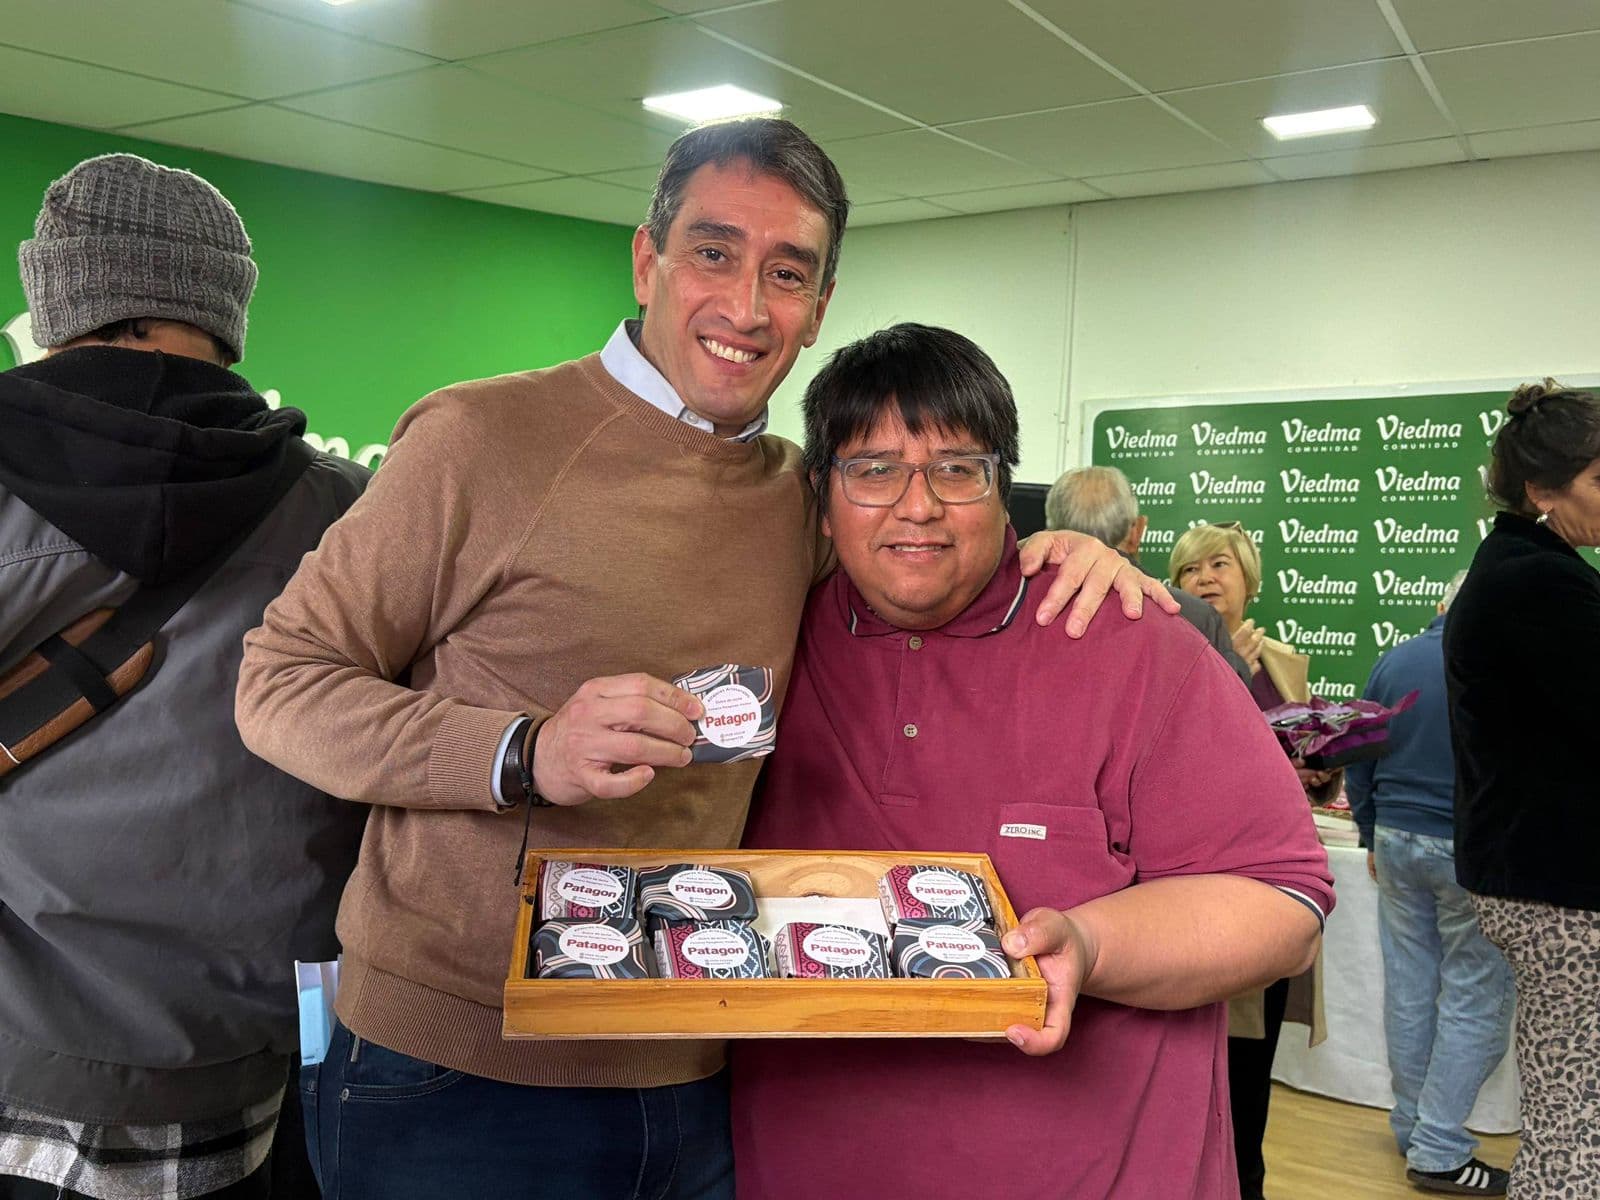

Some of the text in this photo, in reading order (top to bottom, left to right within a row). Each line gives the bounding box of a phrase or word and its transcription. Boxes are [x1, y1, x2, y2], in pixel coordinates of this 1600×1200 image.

[1281, 419, 1361, 443] Viedma
[1376, 415, 1462, 440] Viedma
[1105, 426, 1178, 448] Viedma
[1191, 422, 1267, 446] Viedma
[1287, 445, 1358, 454] COMUNIDAD
[1382, 441, 1459, 451] COMUNIDAD
[1110, 450, 1175, 459] COMUNIDAD
[1196, 447, 1264, 457] COMUNIDAD
[1189, 470, 1266, 494] Viedma
[1279, 469, 1360, 493] Viedma
[1374, 467, 1461, 491] Viedma
[1139, 498, 1173, 506] NIDAD
[1194, 497, 1263, 505] COMUNIDAD
[1285, 495, 1357, 504] COMUNIDAD
[1381, 494, 1457, 503] COMUNIDAD
[1278, 519, 1359, 543] Viedma
[1373, 518, 1460, 543] Viedma
[1137, 546, 1172, 554] NIDAD
[1284, 546, 1355, 554] COMUNIDAD
[1380, 546, 1456, 554] COMUNIDAD
[1277, 569, 1358, 594] Viedma
[1282, 597, 1354, 605] COMUNIDAD
[1378, 598, 1437, 607] COMUNID
[1275, 619, 1358, 646] Viedma
[1297, 647, 1354, 657] MUNIDAD
[705, 711, 757, 728] Patagon
[1005, 826, 1028, 834] ZERO
[563, 882, 617, 898] Patagon
[675, 884, 728, 895] Patagon
[915, 886, 967, 896] Patagon
[566, 938, 624, 953] Patagon
[810, 943, 866, 956] Patagon
[926, 940, 981, 951] Patagon
[687, 947, 745, 956] Patagon
